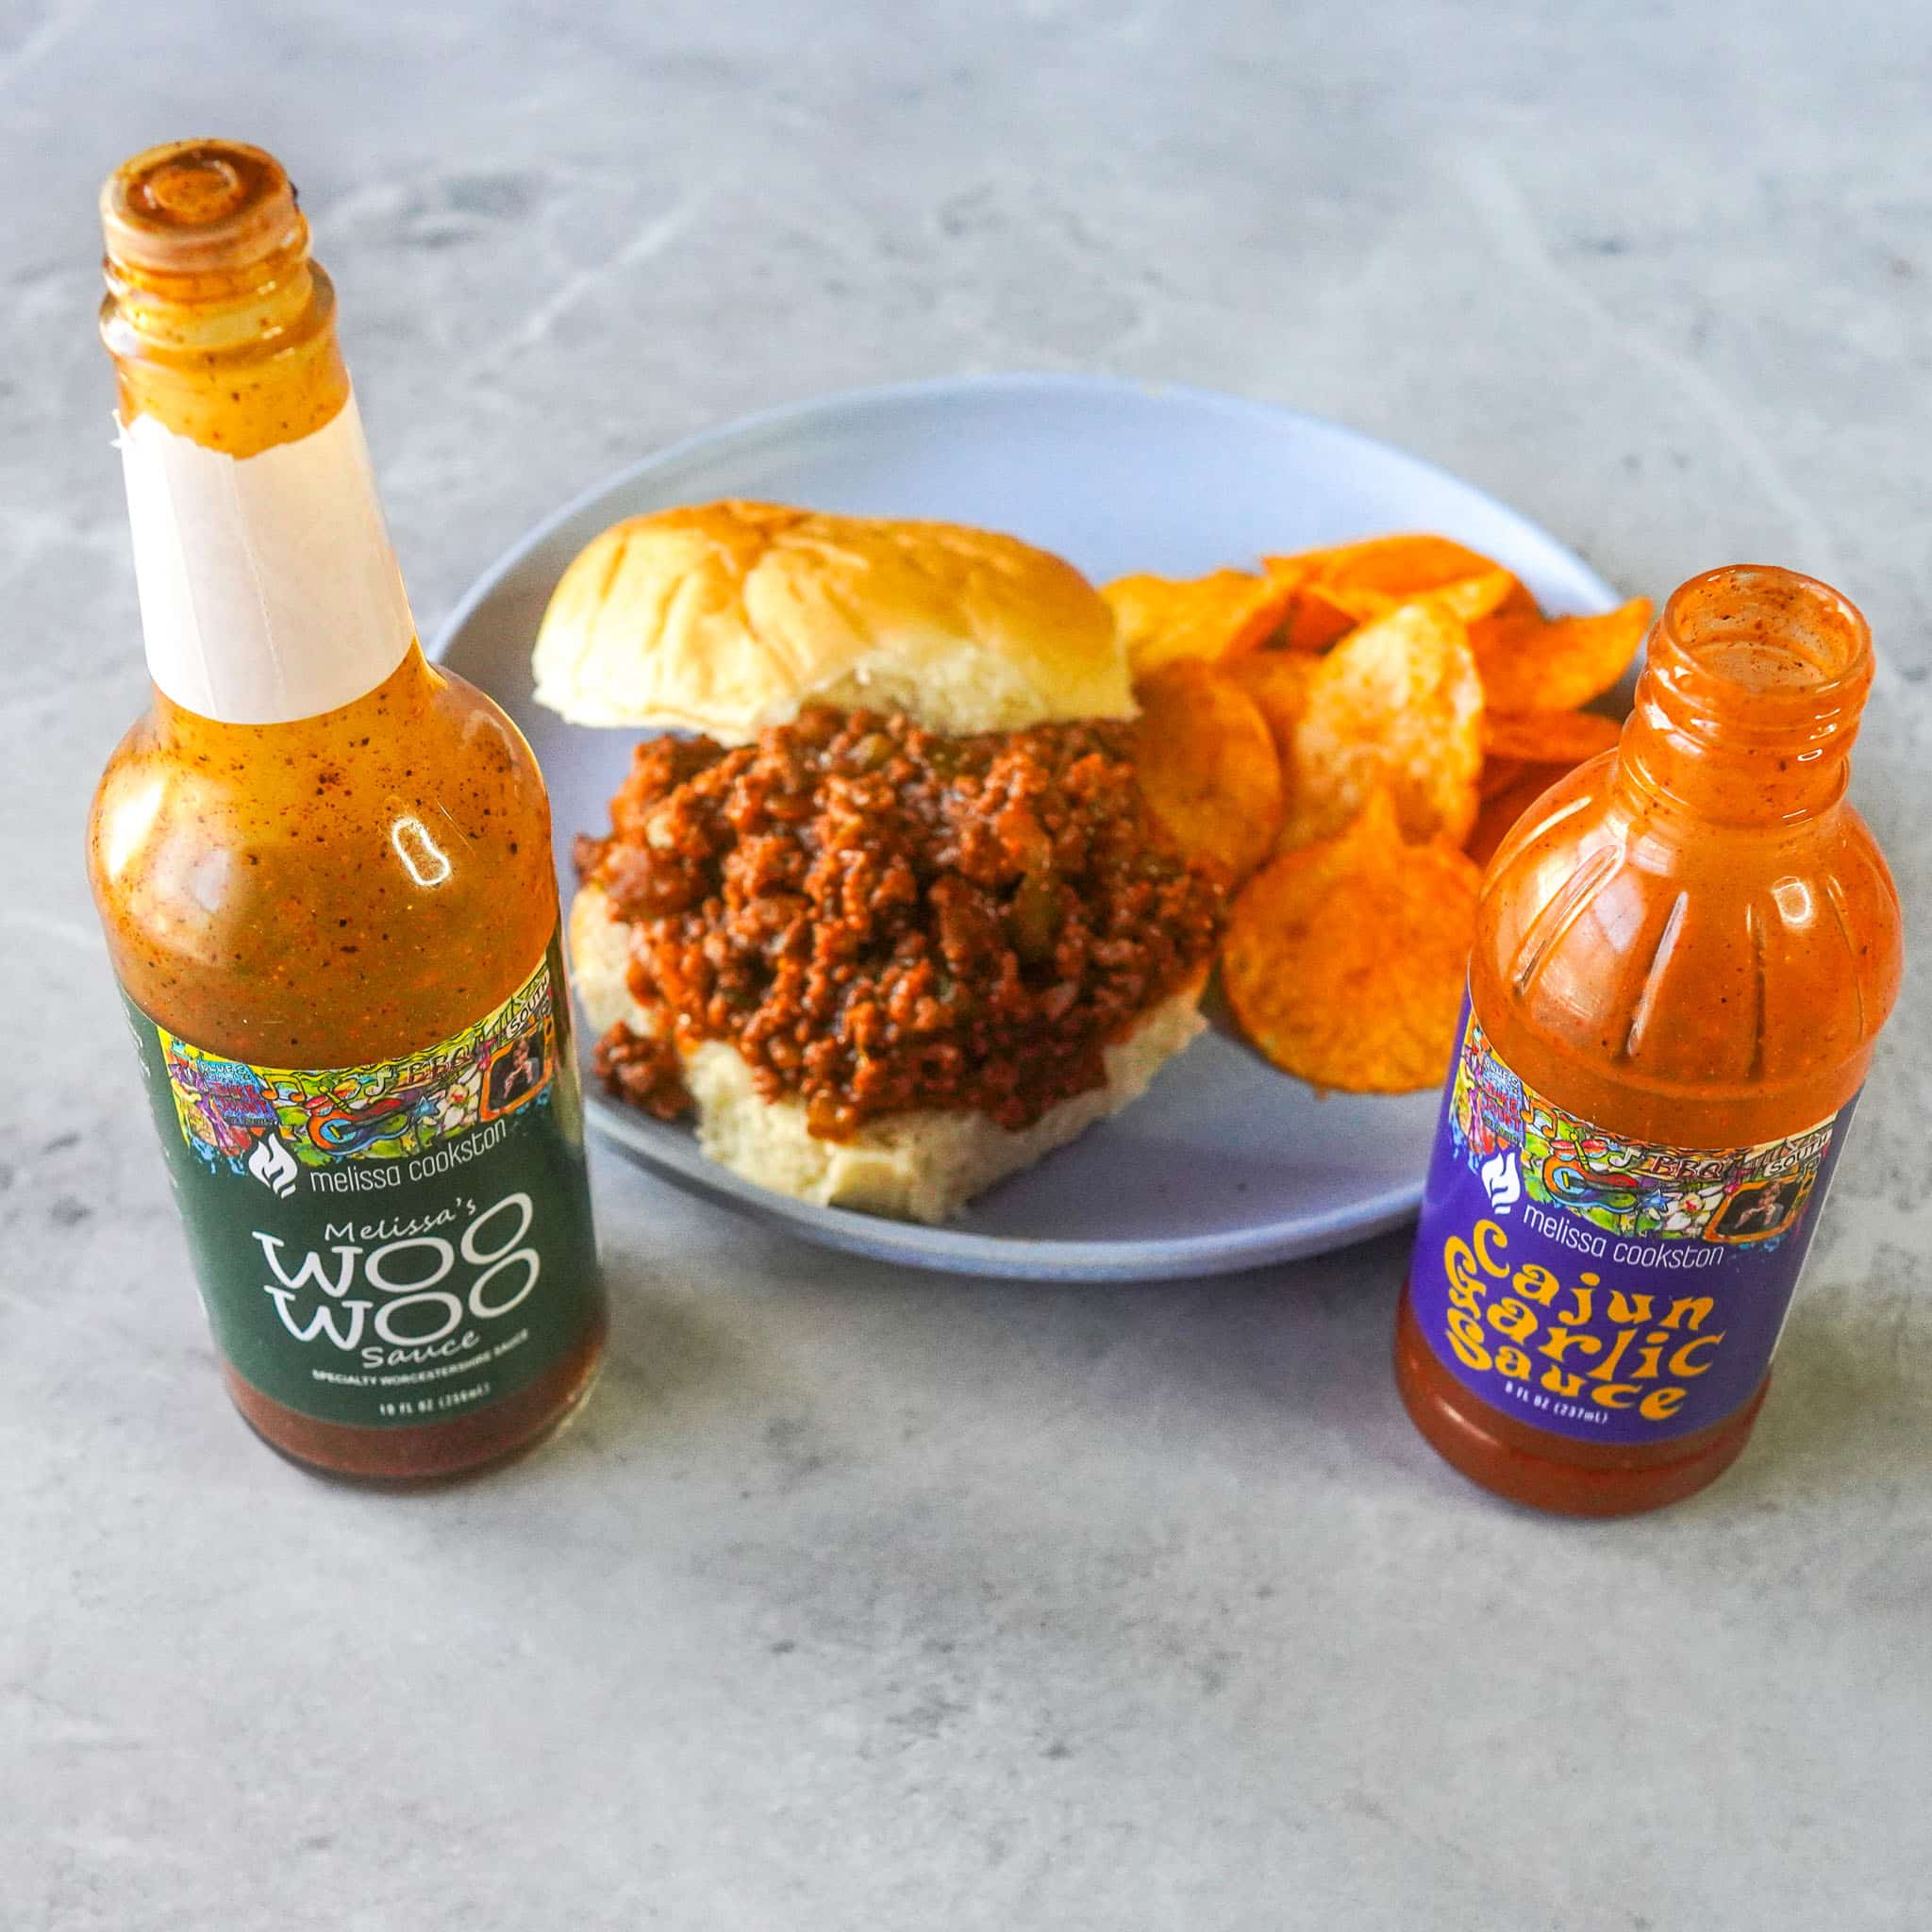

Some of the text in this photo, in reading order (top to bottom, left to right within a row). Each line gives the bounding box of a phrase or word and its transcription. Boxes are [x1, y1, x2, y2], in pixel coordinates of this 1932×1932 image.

[309, 1118, 507, 1192] melissa cookston
[1651, 1154, 1723, 1179] BBQ
[324, 1196, 476, 1242] Melissa's
[1523, 1204, 1724, 1269] melissa cookston
[1473, 1219, 1714, 1328] Cajun
[1443, 1235, 1726, 1380] Garlic
[311, 1368, 377, 1386] SPECIALTY
[380, 1350, 491, 1386] WORCESTERSHIRE
[1445, 1306, 1688, 1422] Sauce
[399, 1400, 413, 1415] FL
[1516, 1386, 1529, 1403] FL
